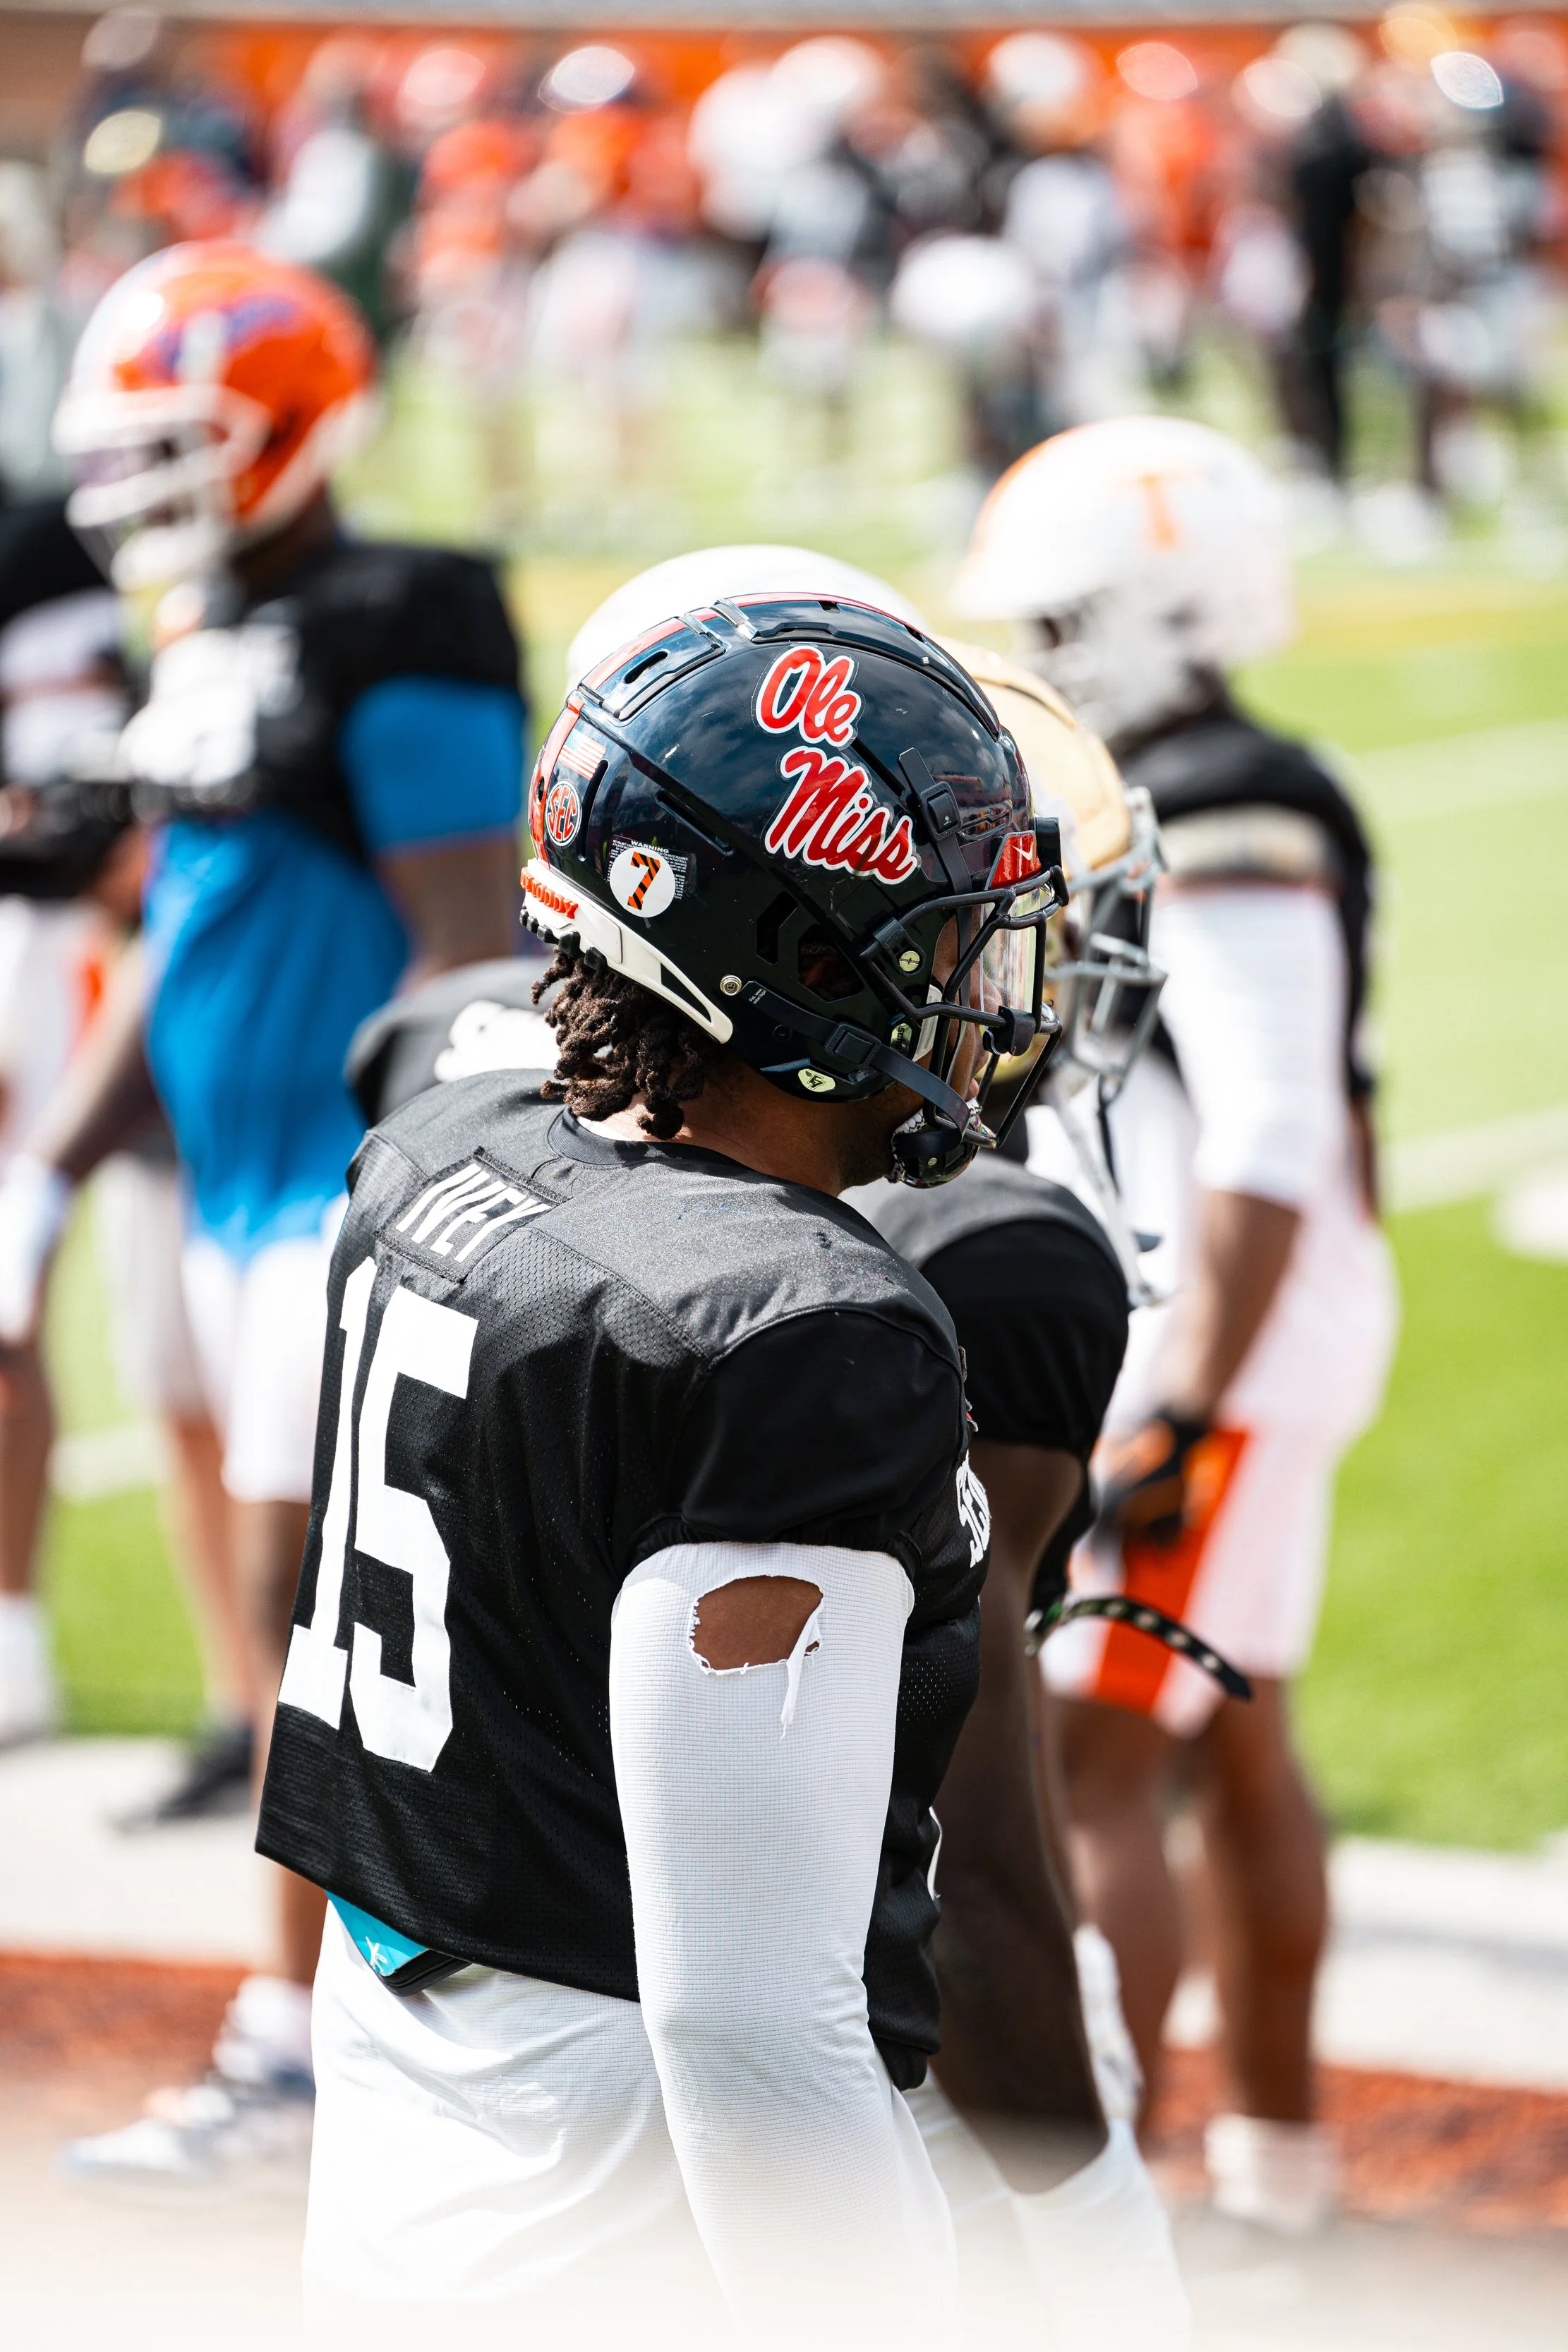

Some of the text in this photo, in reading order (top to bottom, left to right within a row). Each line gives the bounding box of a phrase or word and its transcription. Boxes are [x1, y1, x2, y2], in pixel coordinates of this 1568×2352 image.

[756, 646, 862, 747] Ole
[548, 785, 577, 842] SEC
[631, 840, 669, 853] WARNING
[765, 746, 917, 885] Miss
[627, 851, 661, 910] 7
[395, 1163, 552, 1263] IVEY
[277, 1256, 479, 1773] 15
